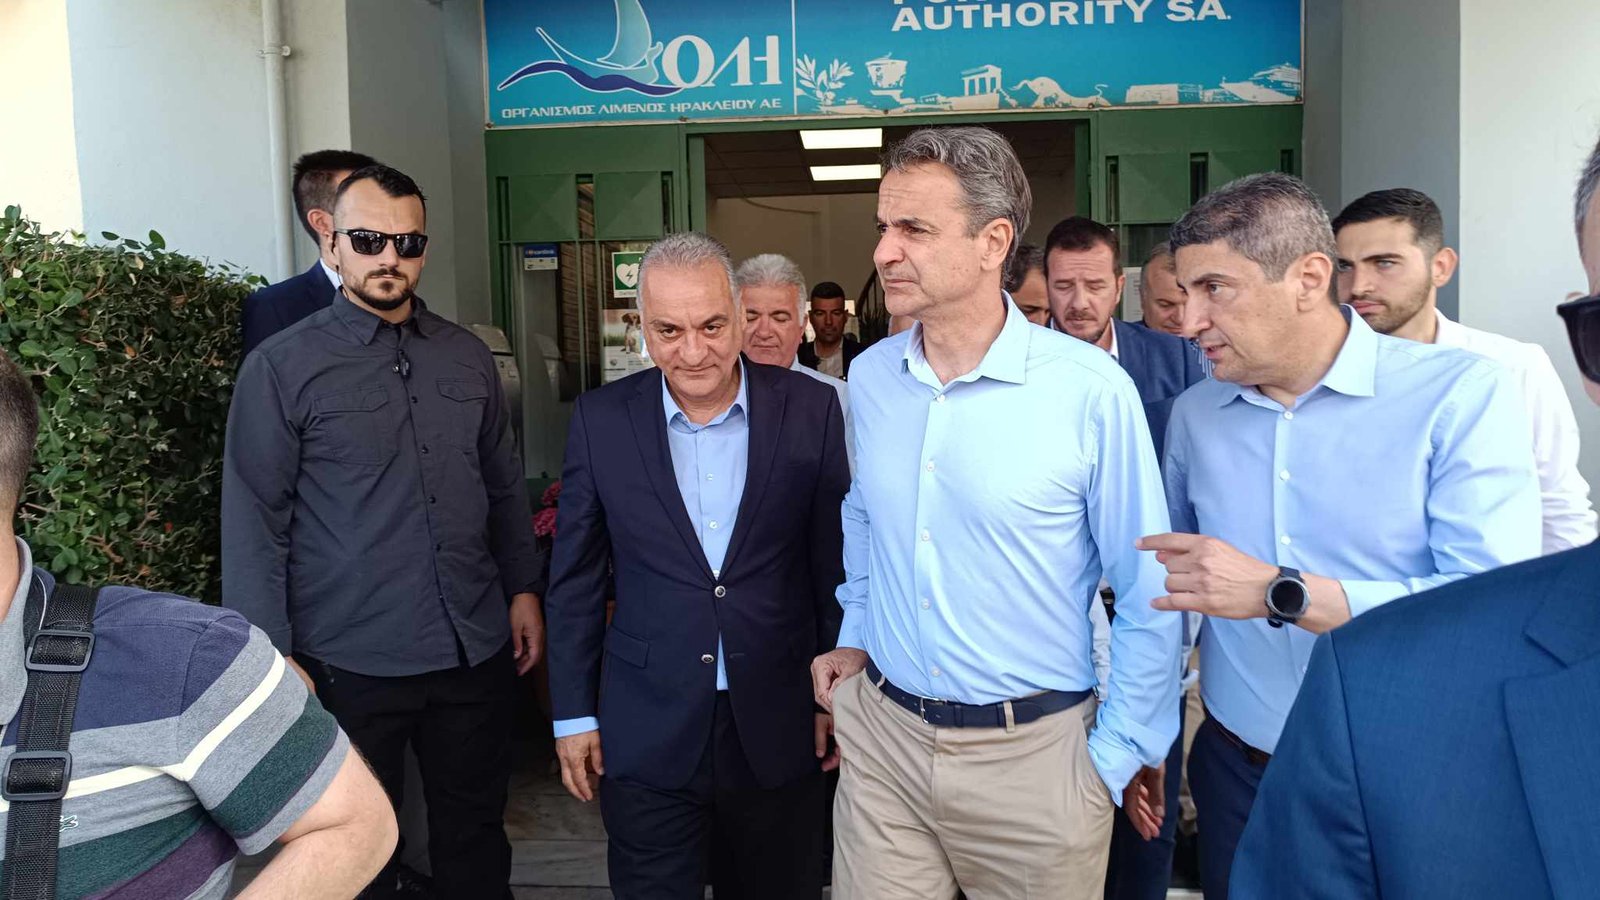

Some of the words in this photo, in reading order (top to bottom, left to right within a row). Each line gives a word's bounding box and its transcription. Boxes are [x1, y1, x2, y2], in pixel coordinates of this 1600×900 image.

[891, 0, 1151, 31] AUTHORITY
[1166, 0, 1232, 22] S.A.
[501, 104, 596, 118] ΟΡΓΑΝΙΣΜΟΣ
[598, 102, 666, 114] ΛΙΜΕΝΟΣ
[670, 99, 757, 112] ΗΡΑΚΛΕΙΟΥ
